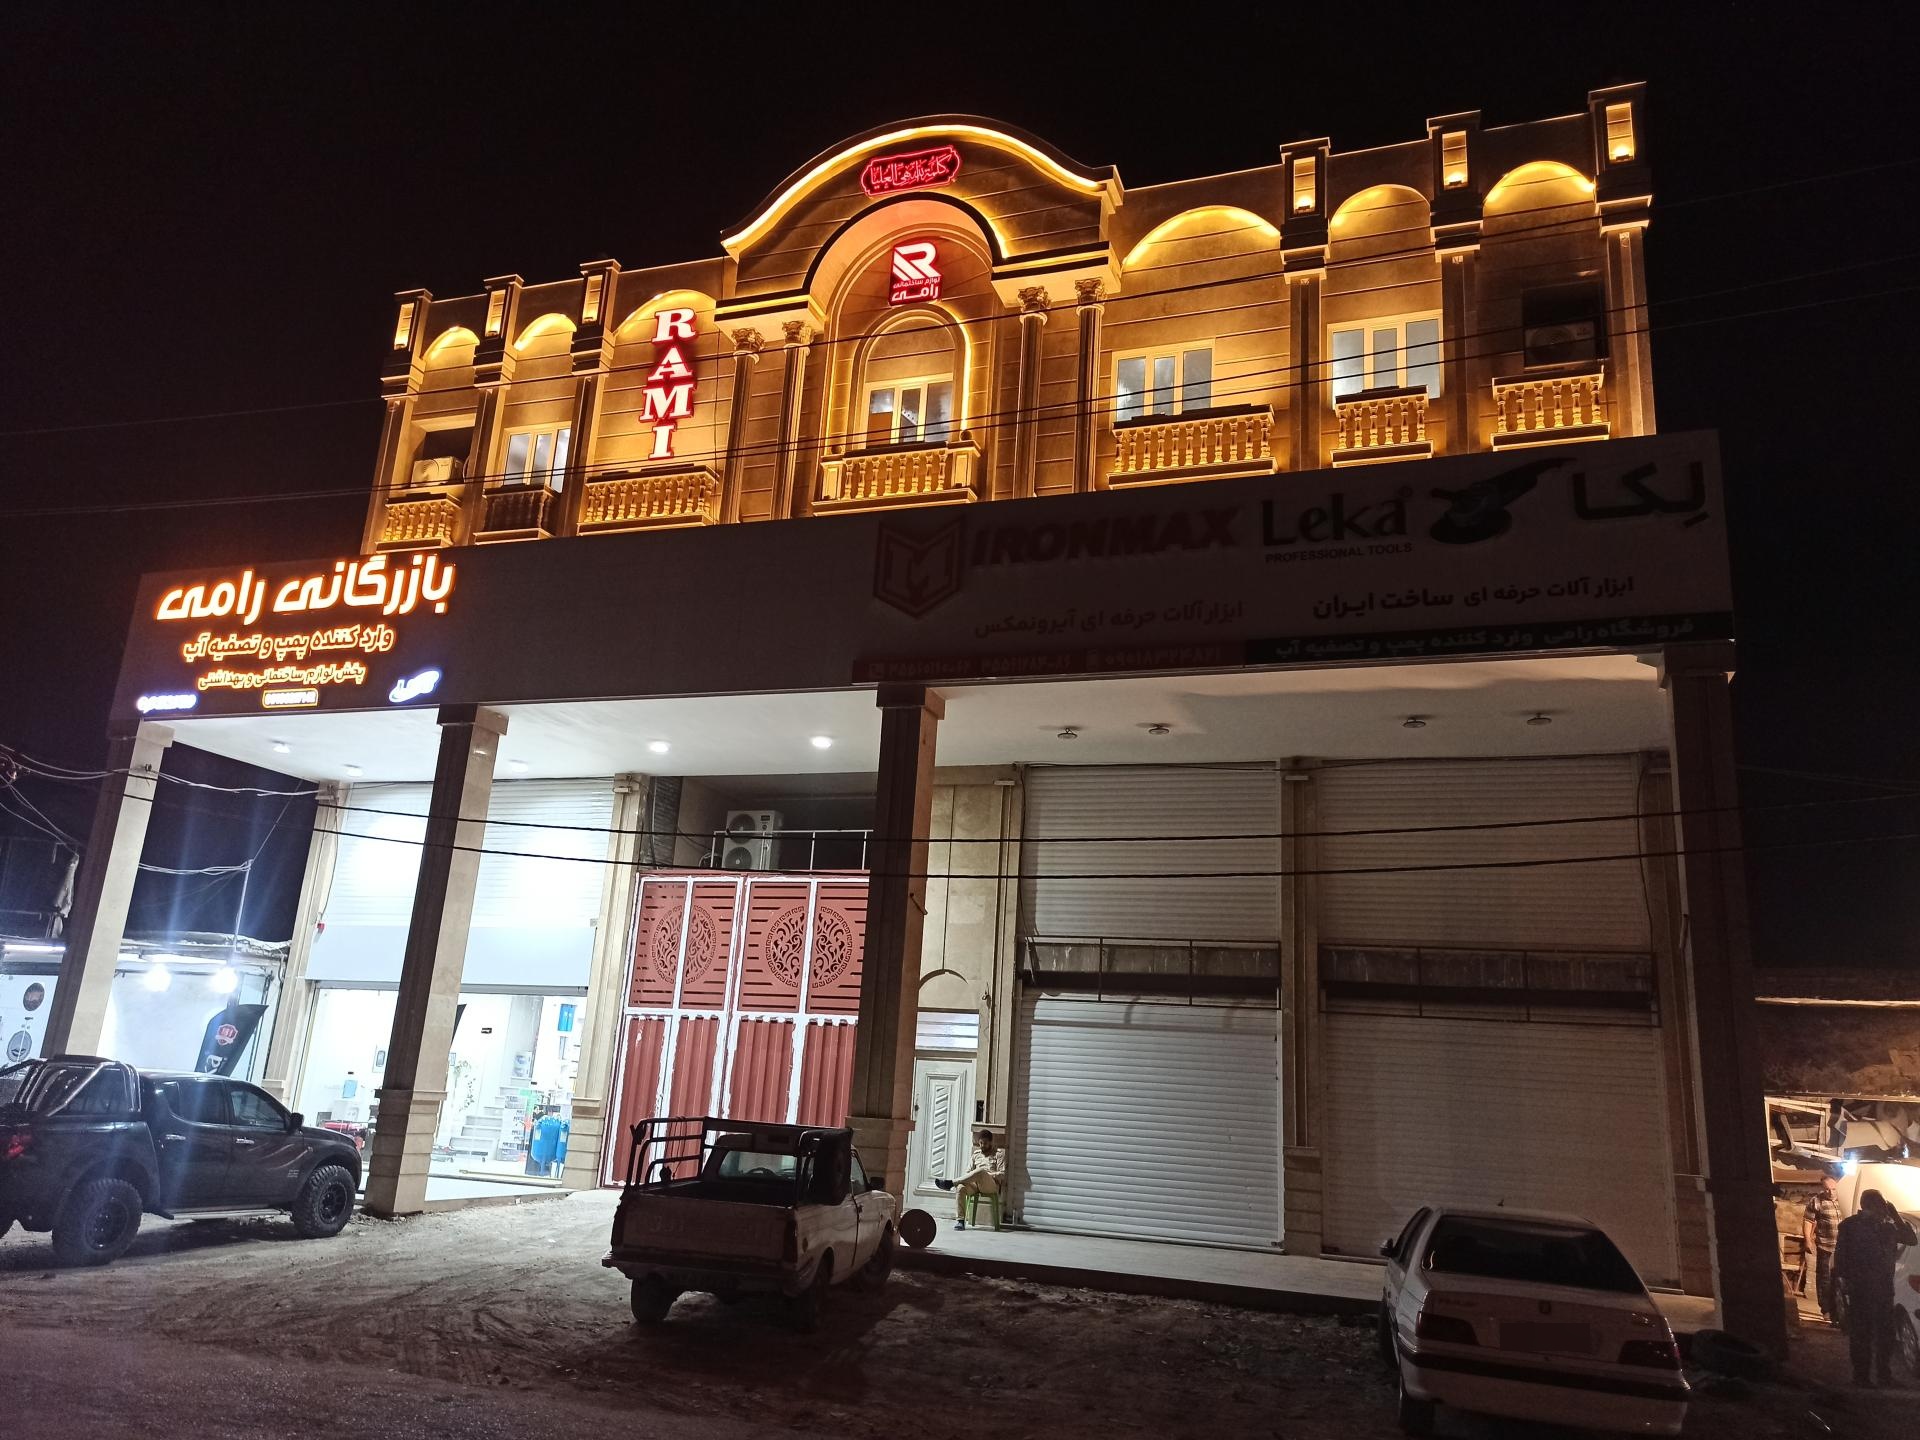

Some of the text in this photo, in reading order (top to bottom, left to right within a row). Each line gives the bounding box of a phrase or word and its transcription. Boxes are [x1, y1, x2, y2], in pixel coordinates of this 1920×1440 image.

[640, 308, 695, 458] RAMI
[970, 506, 1244, 567] IRONMAX
[1261, 493, 1407, 546] Leka
[1265, 542, 1413, 563] PROFESSIONAL TOOLS
[156, 553, 456, 625] بازرگانی رامی
[1312, 576, 1634, 620] ابزار آلات حرفه ای ساخت ایران
[975, 600, 1243, 639] ابزار آلات حرفه ای آیرونمکس
[1276, 618, 1694, 658] فروشگاه رامی وارد کننده پمپ و تصفیه آب
[184, 624, 395, 663] وارد کننده پمپ و تصفیه آب
[198, 661, 366, 690] پخش لوازم ساختمانی و بهداشتی
